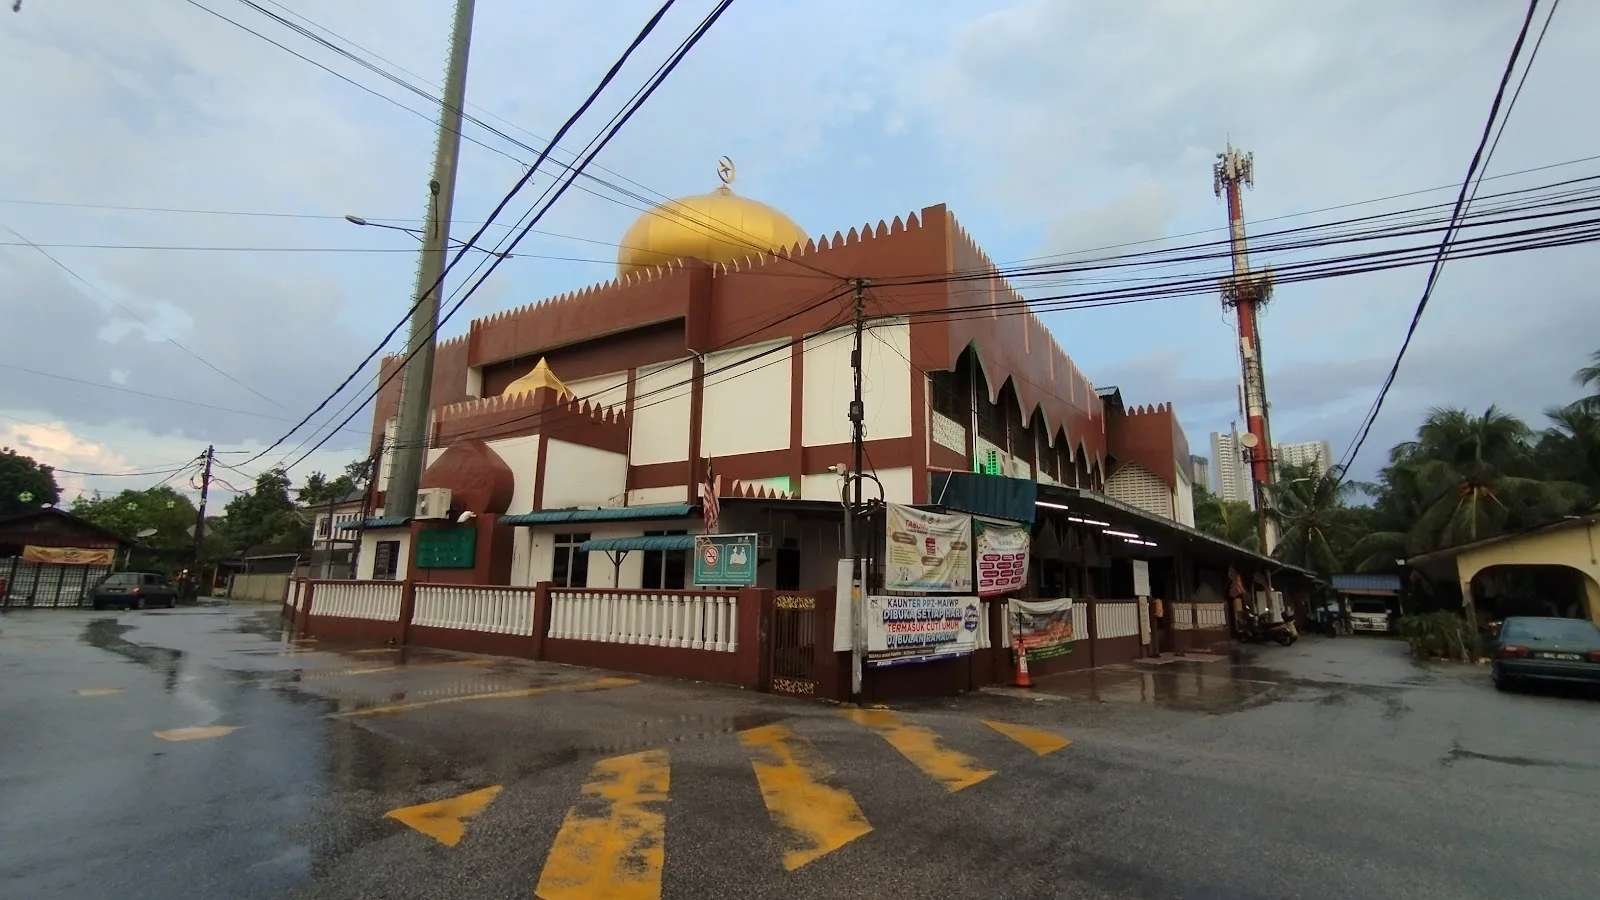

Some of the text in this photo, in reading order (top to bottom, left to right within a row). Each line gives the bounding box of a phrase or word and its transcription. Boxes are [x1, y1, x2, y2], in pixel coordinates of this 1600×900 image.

[888, 598, 921, 608] KAUNTER
[923, 598, 959, 608] PPZ-MAIWP
[883, 608, 962, 621] DIBUKA SETIAP HARI
[888, 621, 959, 633] TERMASUK CUTI UMUM
[887, 635, 895, 646] DI
[897, 633, 924, 645] BULAN
